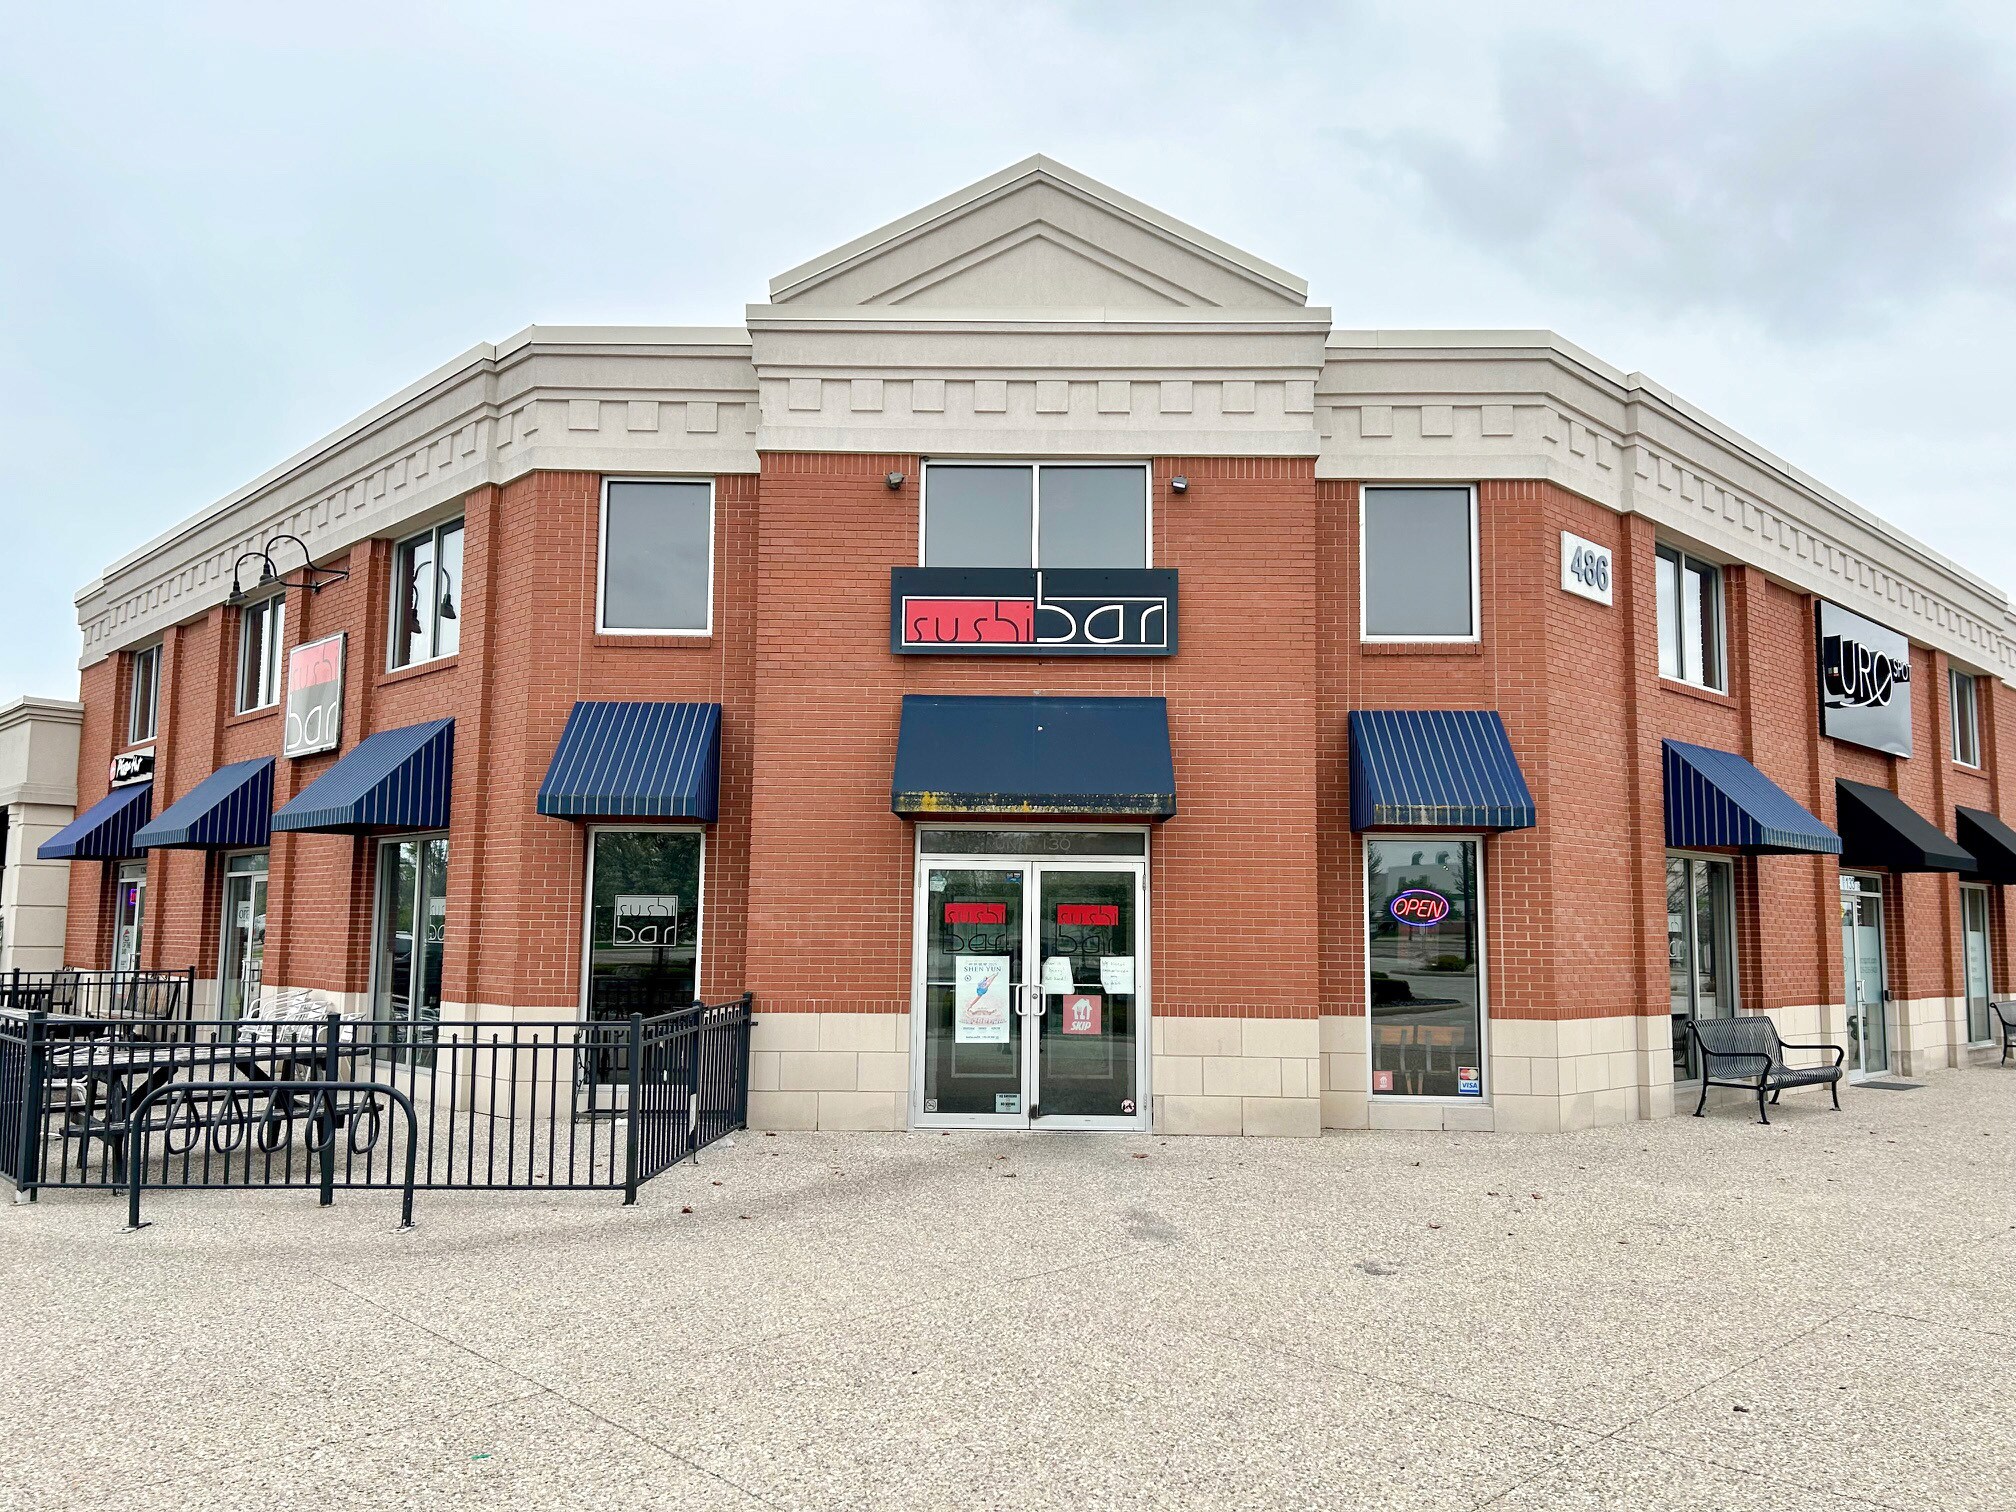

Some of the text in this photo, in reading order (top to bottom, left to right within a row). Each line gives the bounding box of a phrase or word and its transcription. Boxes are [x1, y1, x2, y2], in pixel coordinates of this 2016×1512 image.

[1571, 545, 1609, 591] 486
[913, 571, 1164, 643] sushi bar
[287, 693, 337, 750] bar
[1043, 838, 1071, 850] 130
[619, 897, 674, 916] sushi
[947, 905, 1005, 925] sushi
[1060, 905, 1117, 926] sushi
[1393, 898, 1444, 918] OPEN
[616, 915, 675, 944] bar
[945, 924, 1006, 952] bar
[1057, 925, 1113, 954] bar
[1070, 1021, 1092, 1031] SKIP
